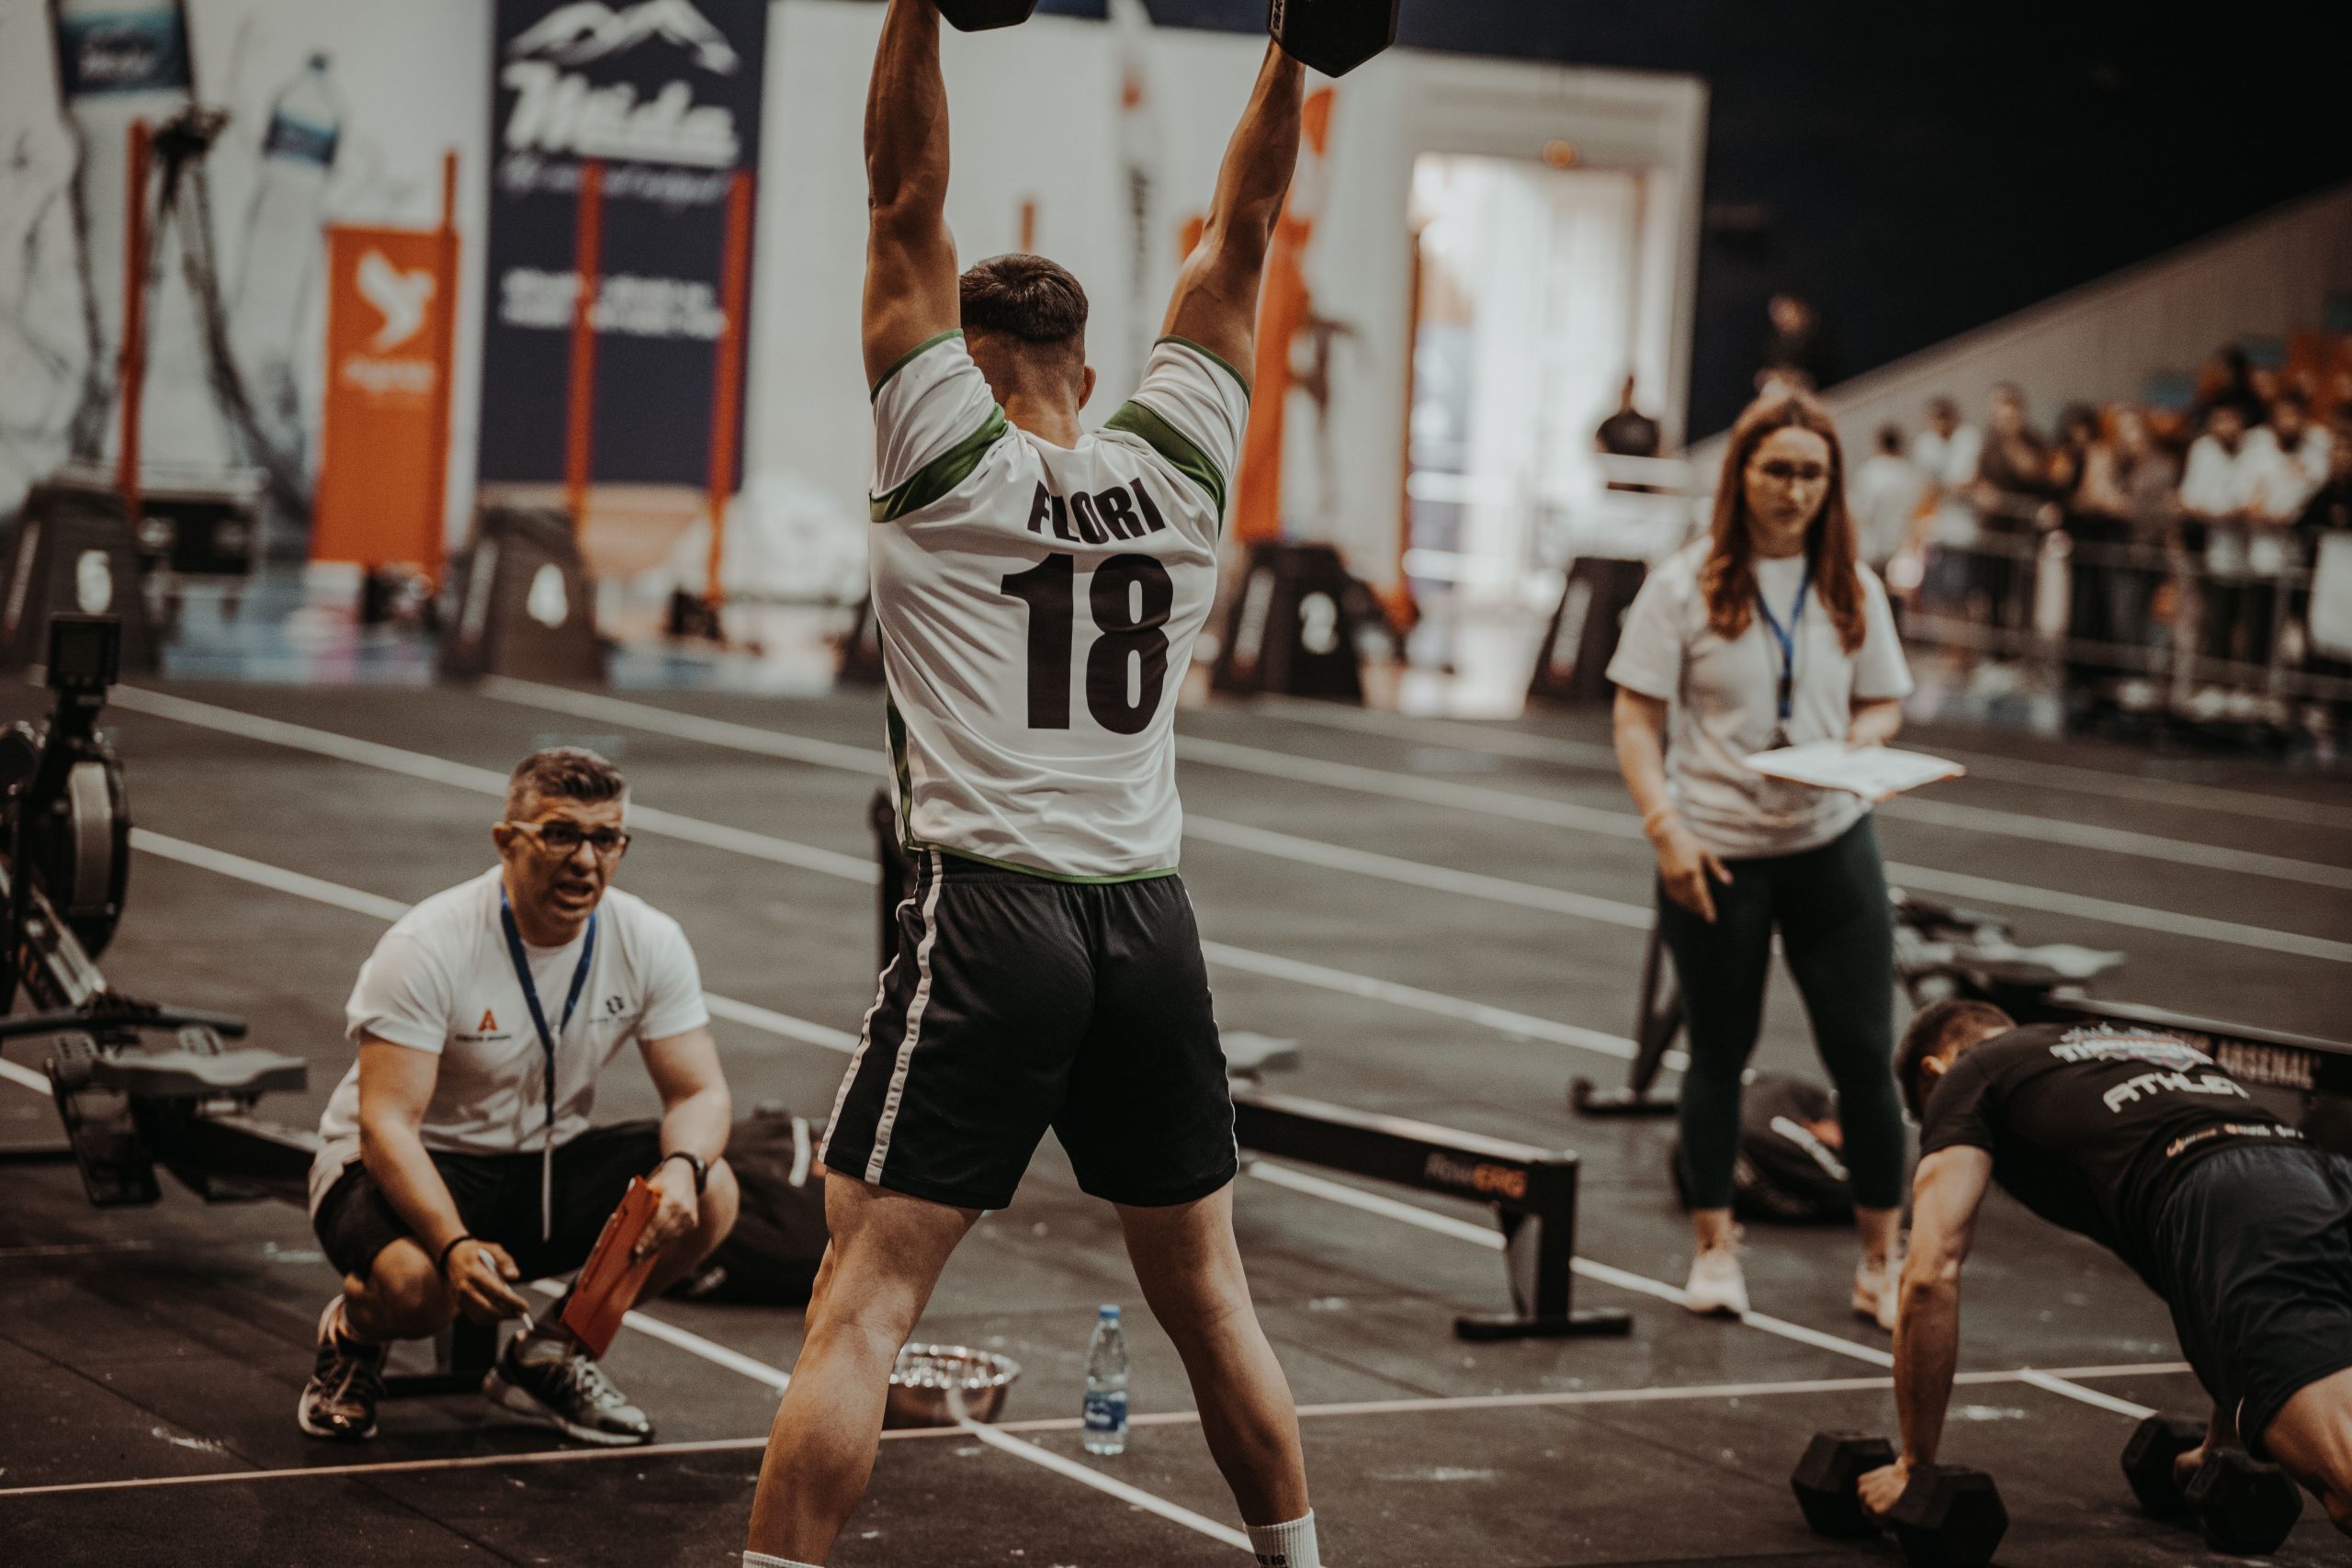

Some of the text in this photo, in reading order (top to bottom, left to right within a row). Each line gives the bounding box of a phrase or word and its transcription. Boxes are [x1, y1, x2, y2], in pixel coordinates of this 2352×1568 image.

[1027, 477, 1166, 545] FLORI
[75, 548, 112, 615] 6
[1001, 553, 1173, 735] 18
